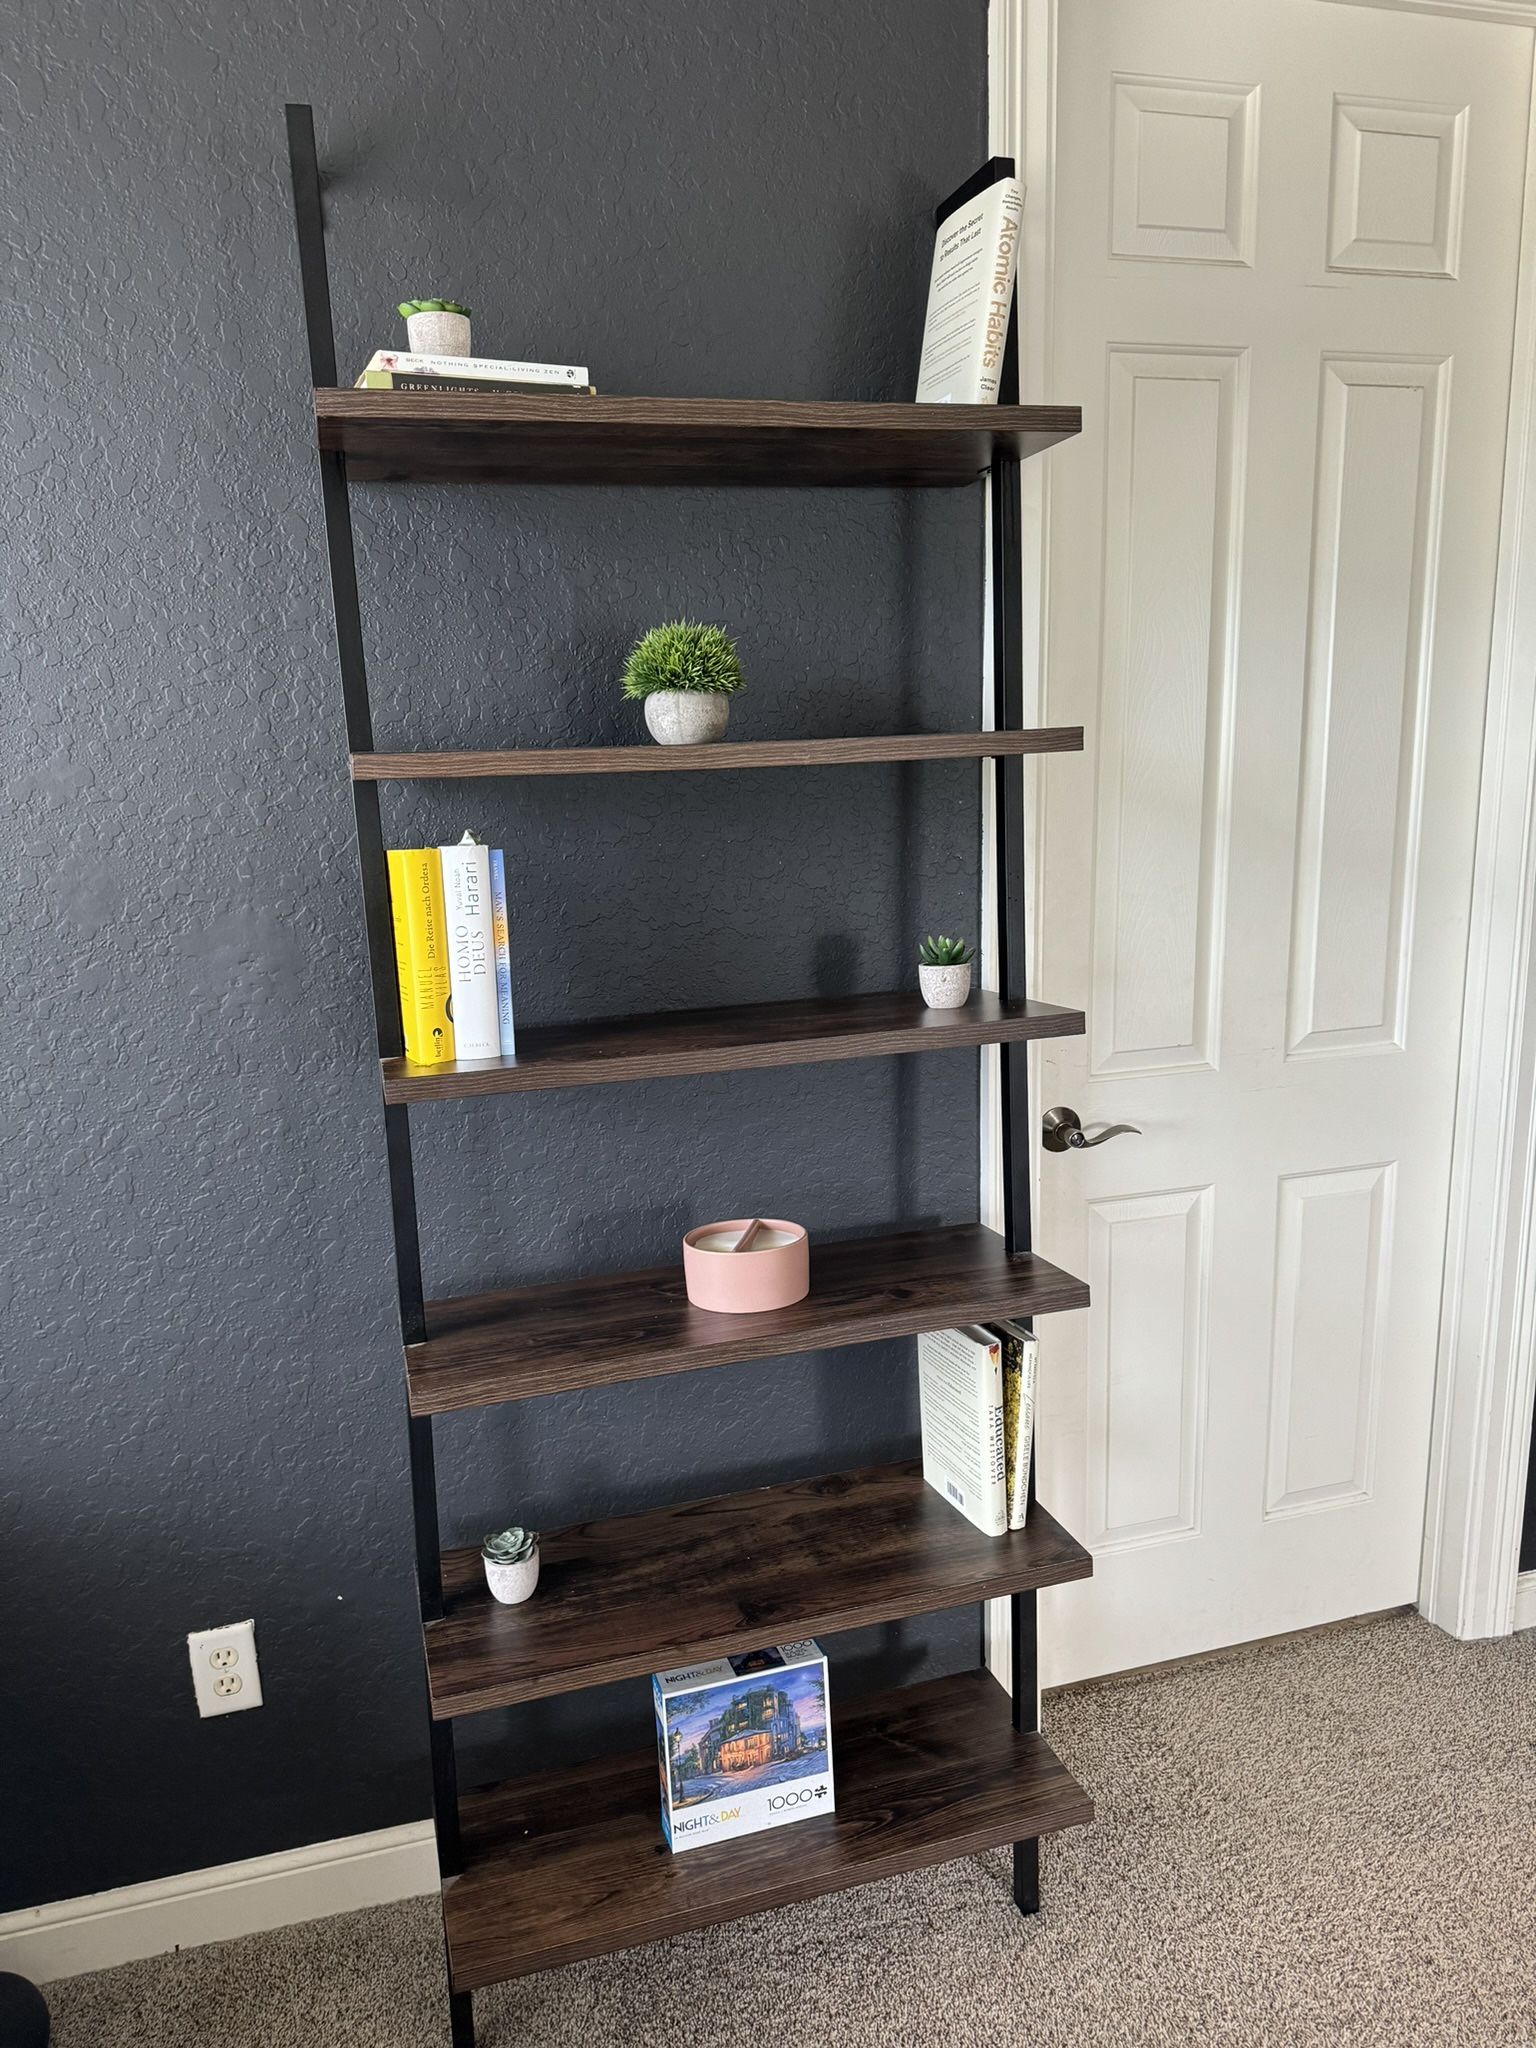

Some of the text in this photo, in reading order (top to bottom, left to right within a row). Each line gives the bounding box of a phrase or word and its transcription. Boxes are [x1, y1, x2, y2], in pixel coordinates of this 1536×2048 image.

[960, 235, 971, 247] That
[971, 227, 982, 239] Last
[968, 213, 984, 229] Secret
[993, 215, 1018, 296] Atomic
[982, 300, 1008, 369] Habits
[430, 360, 469, 368] NOTHING
[419, 862, 435, 959] Die Reise nach Ordesa
[455, 891, 463, 911] Yuval
[461, 862, 480, 916] Harari
[455, 925, 472, 983] HOMO
[471, 930, 486, 975] DEUS
[495, 891, 511, 1025] MAN'S SEARCH FOR MEANING
[417, 967, 434, 1010] MANUEL
[433, 966, 448, 997] VILAS
[994, 1405, 1007, 1482] Educated
[1022, 1436, 1031, 1460] GISELE
[780, 1640, 812, 1652] 1000
[767, 1789, 812, 1811] 1000
